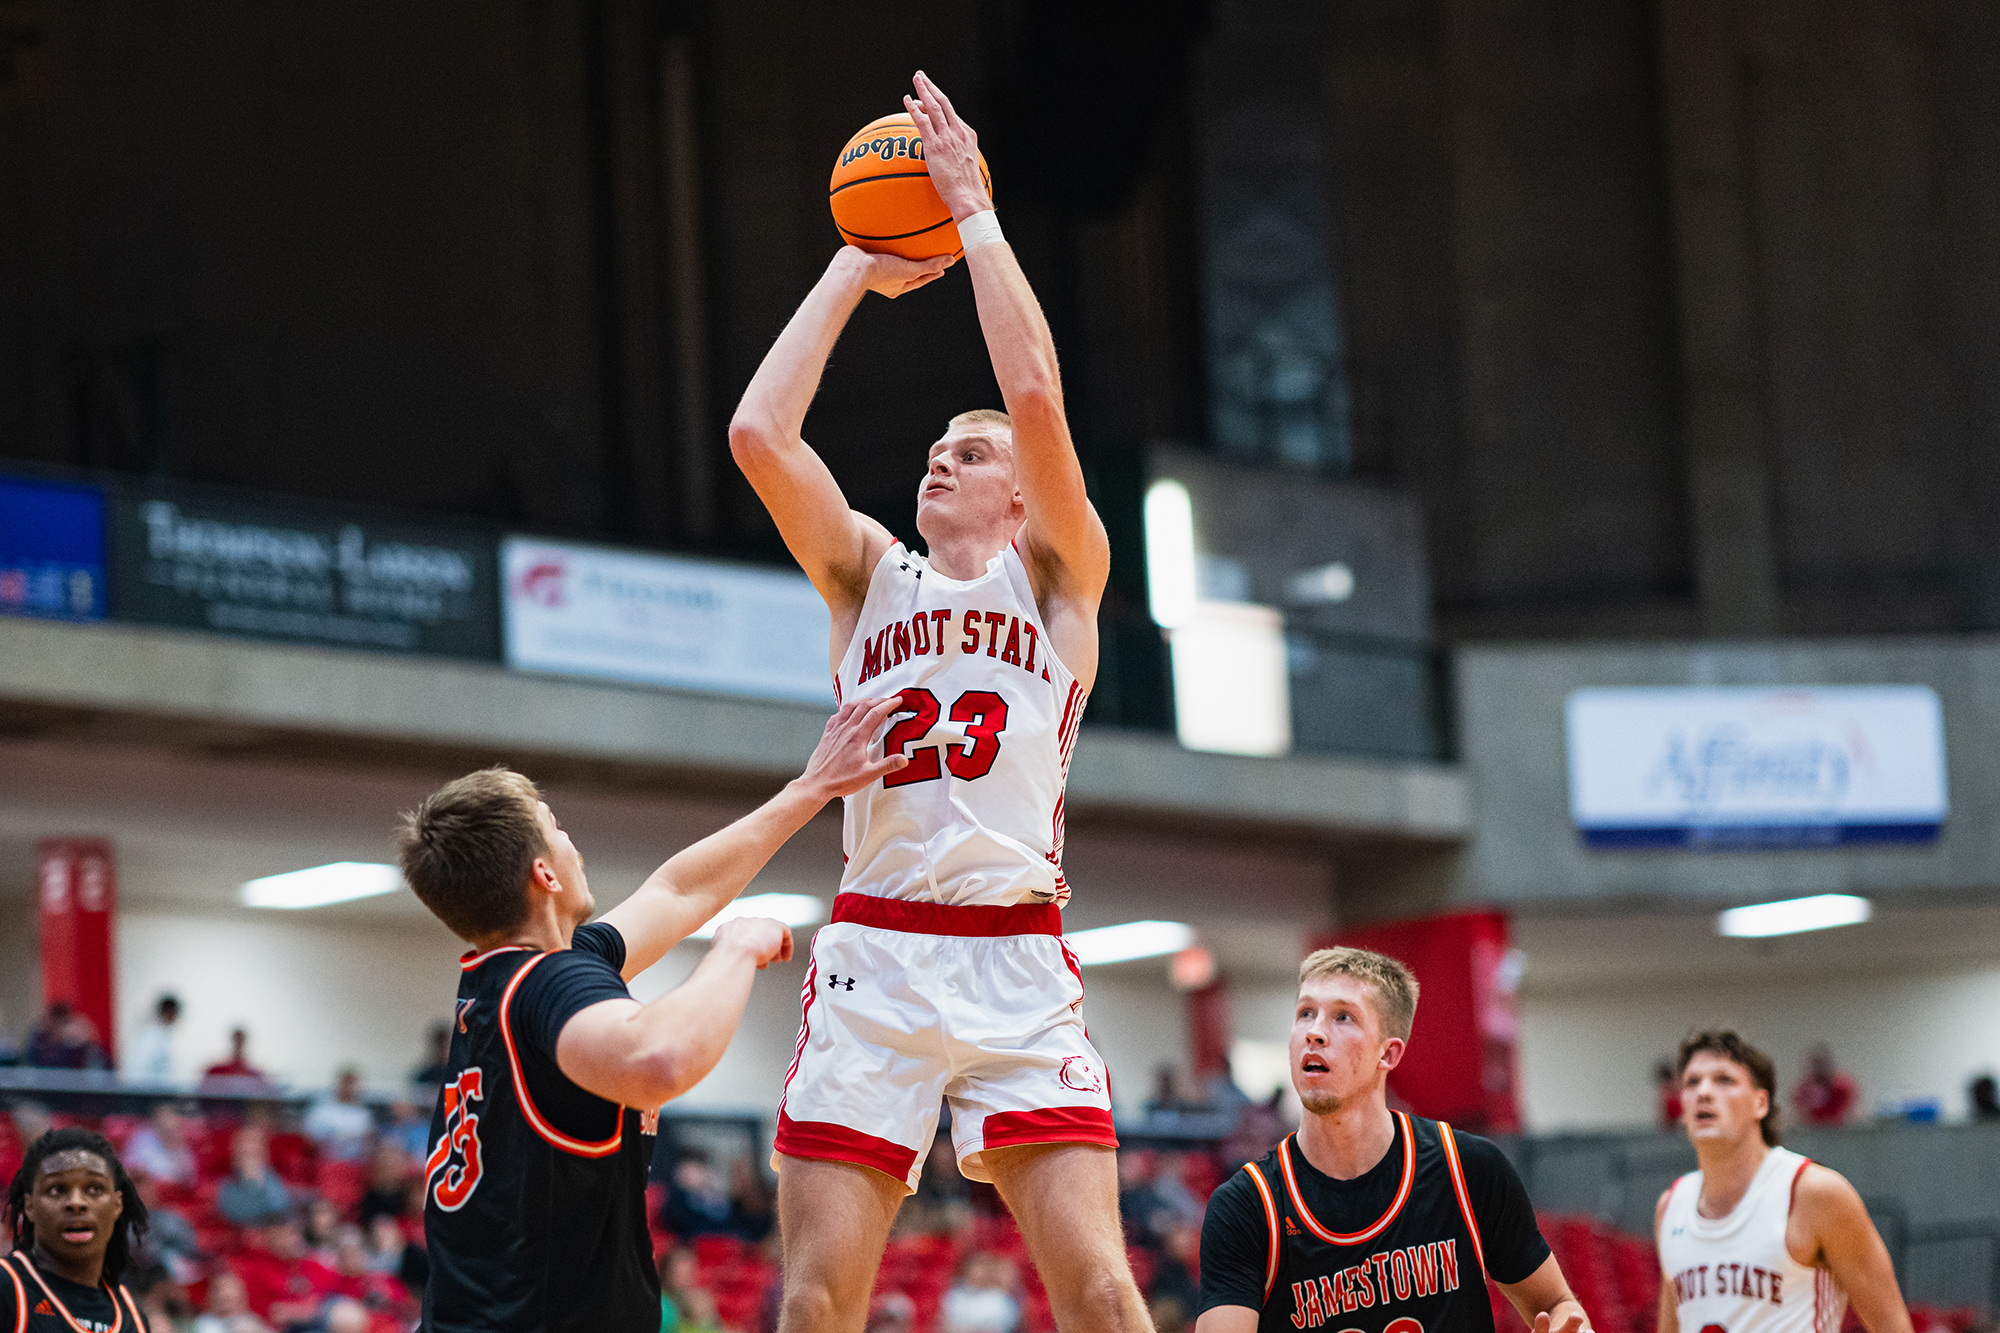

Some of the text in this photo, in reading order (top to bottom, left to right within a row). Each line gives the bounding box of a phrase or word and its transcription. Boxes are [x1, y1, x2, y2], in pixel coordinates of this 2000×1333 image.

[858, 608, 1052, 686] MINOT STAT
[883, 687, 1009, 789] 23
[1290, 1238, 1460, 1329] JAMESTOWN
[1717, 1263, 1783, 1307] STATE
